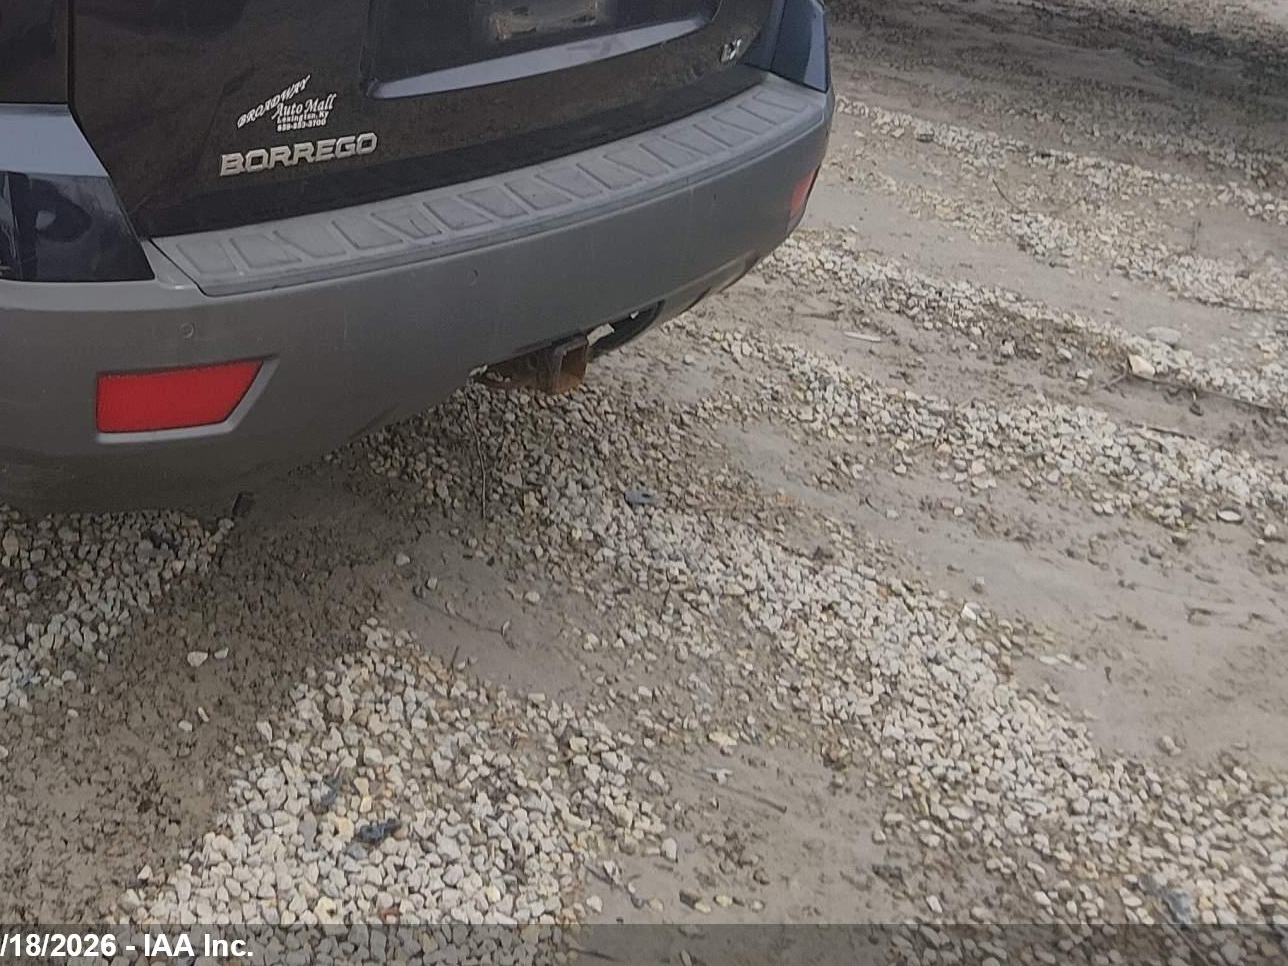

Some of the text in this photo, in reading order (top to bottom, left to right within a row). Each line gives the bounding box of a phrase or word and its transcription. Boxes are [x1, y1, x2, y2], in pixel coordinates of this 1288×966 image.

[237, 74, 311, 129] BROADWAY
[272, 93, 337, 120] Auto Mall
[219, 132, 378, 177] BORREGO
